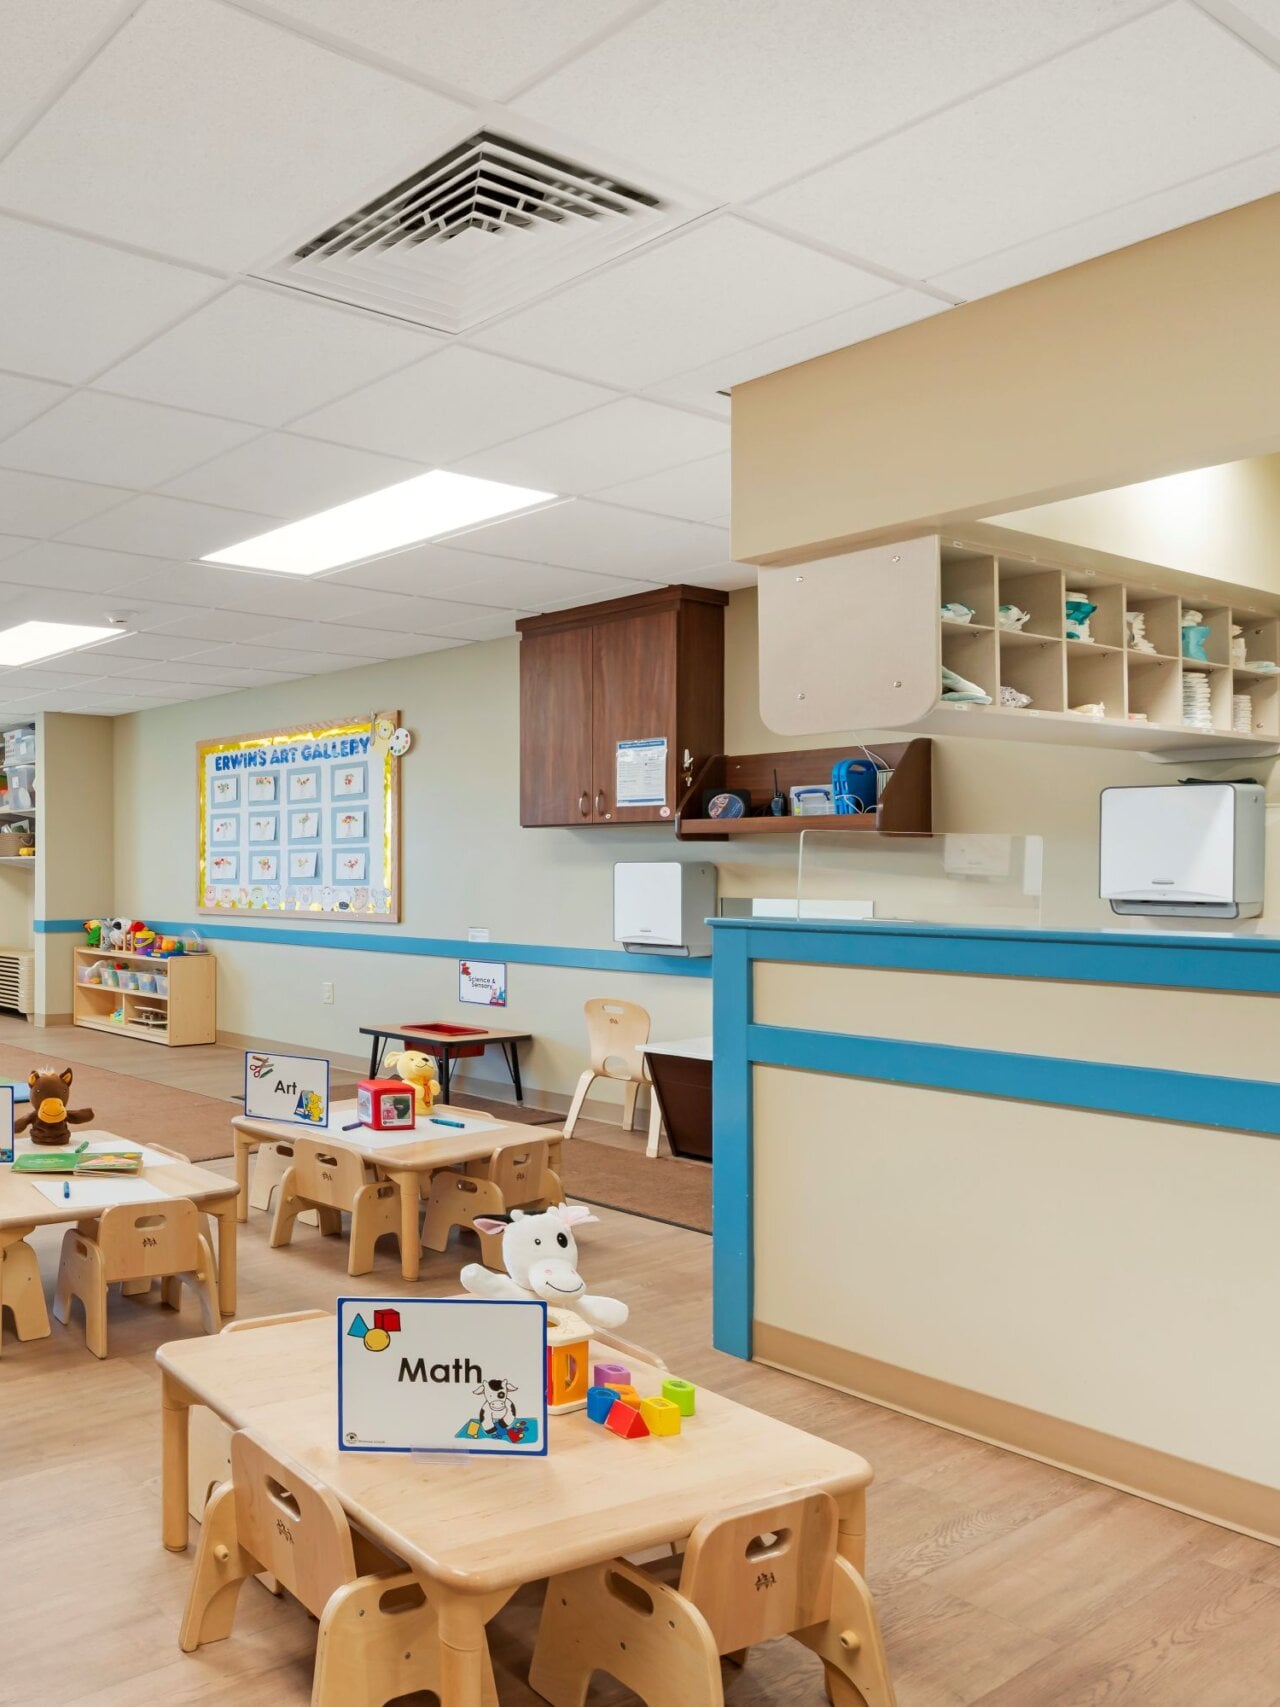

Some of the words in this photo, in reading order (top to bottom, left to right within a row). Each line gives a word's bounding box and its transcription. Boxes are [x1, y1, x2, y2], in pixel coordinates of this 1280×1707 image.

[215, 749, 267, 772] ERWIN'S
[270, 746, 298, 765] ART
[301, 736, 371, 762] GALLERY
[468, 975, 490, 983] Science
[274, 1080, 297, 1095] Art
[398, 1357, 482, 1384] Math
